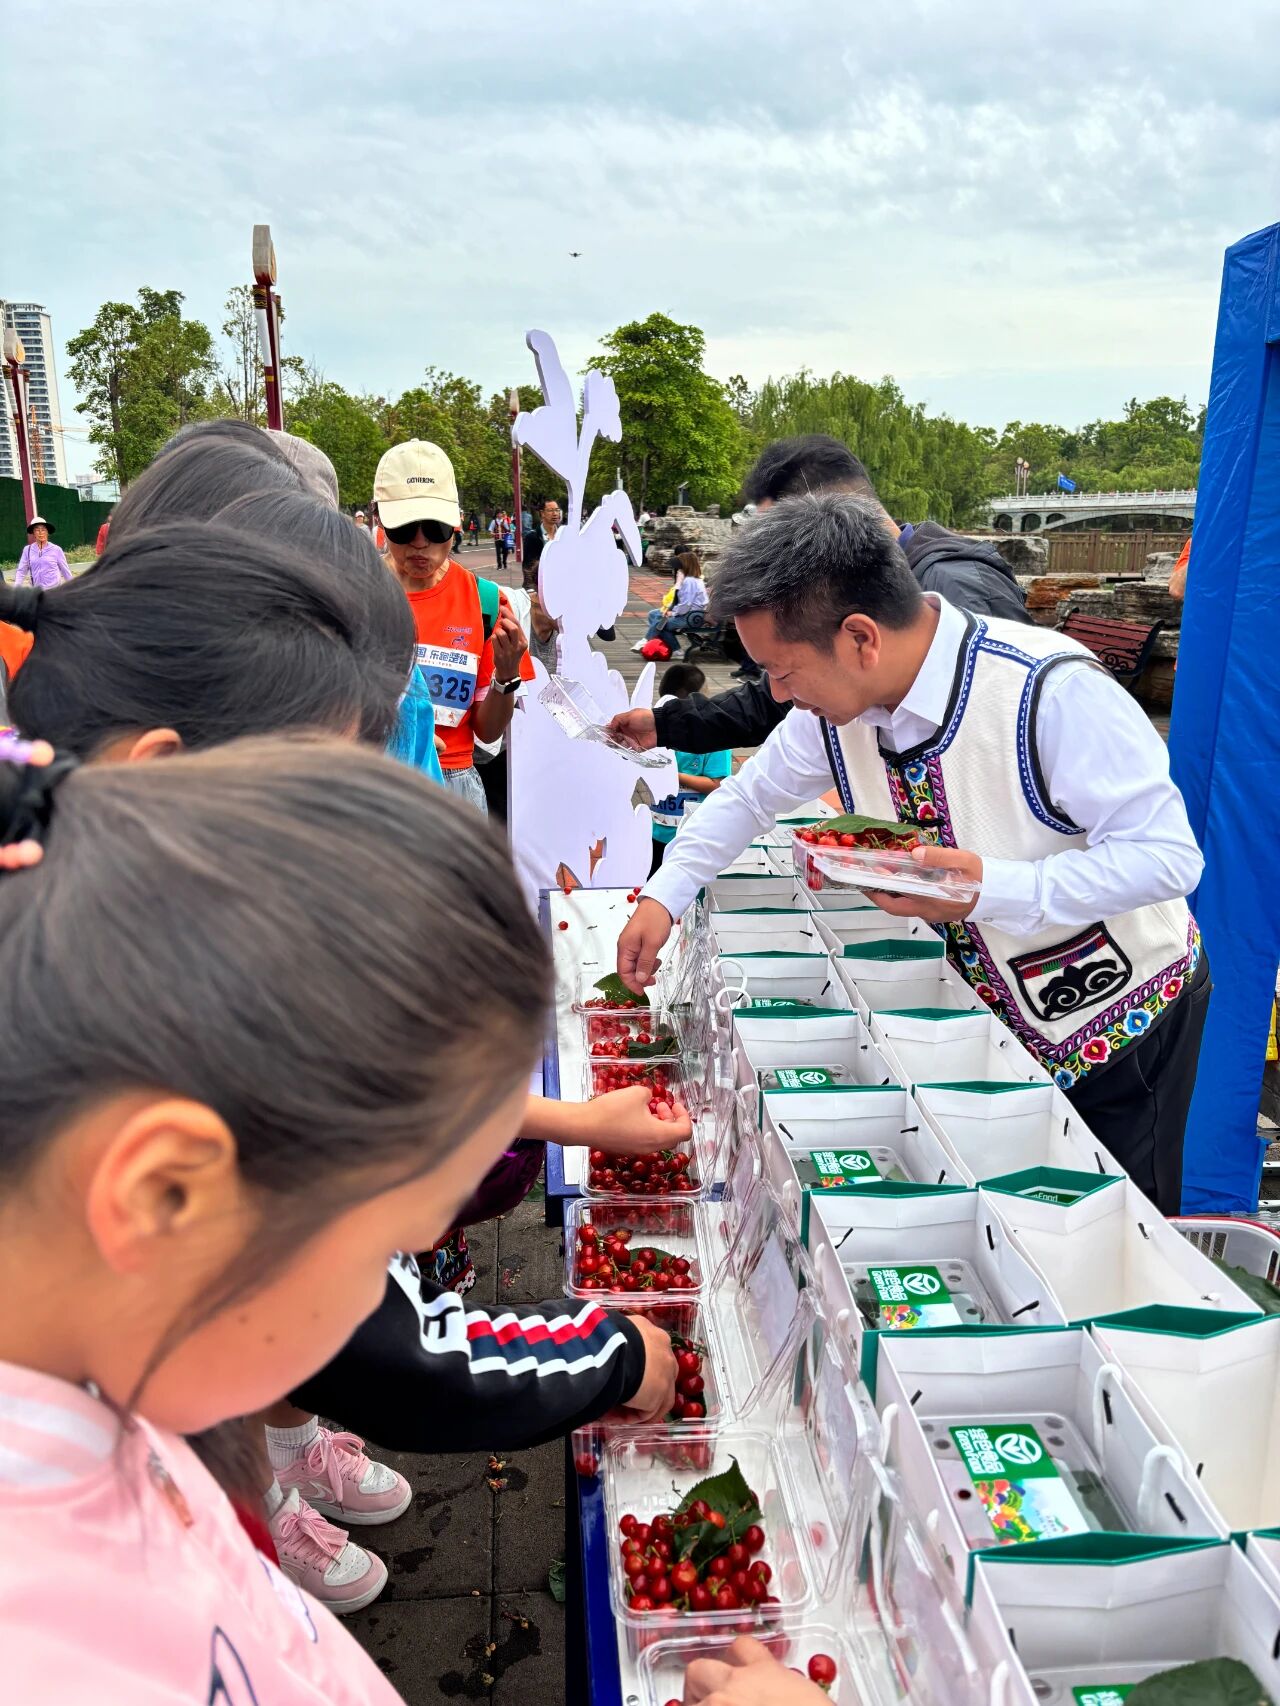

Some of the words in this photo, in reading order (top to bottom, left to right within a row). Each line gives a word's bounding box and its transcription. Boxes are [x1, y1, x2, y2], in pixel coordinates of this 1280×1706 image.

[406, 477, 436, 485] GATHERING
[423, 671, 472, 703] 325
[968, 1428, 1006, 1474] 绿色食品
